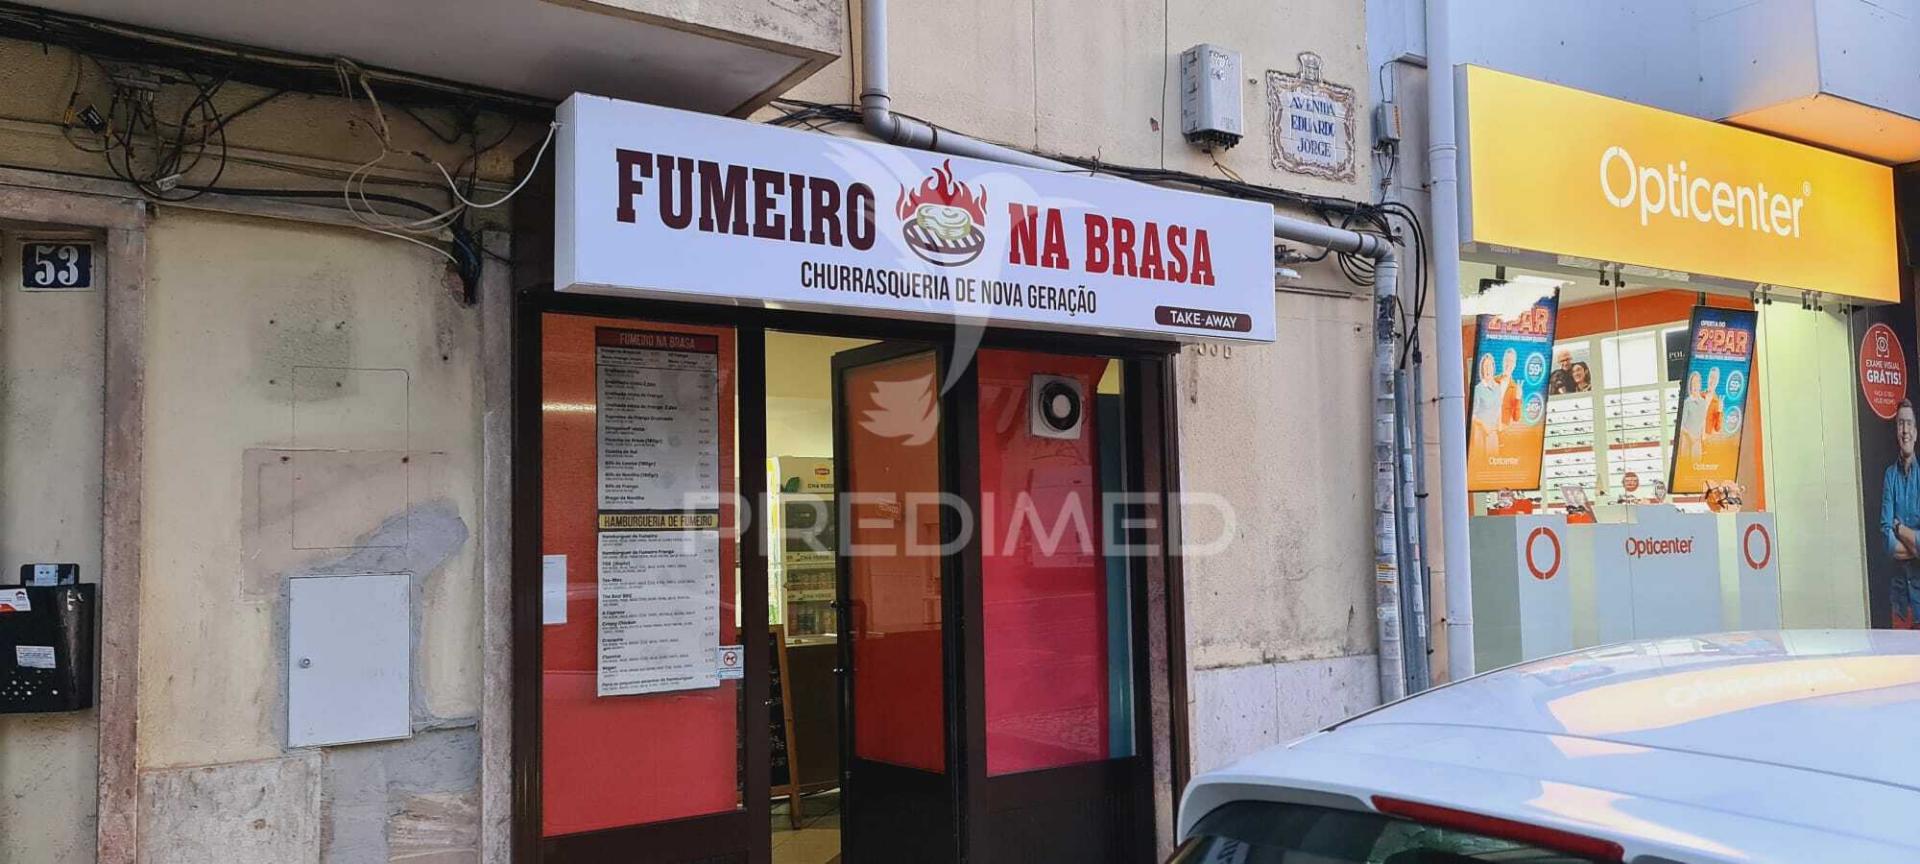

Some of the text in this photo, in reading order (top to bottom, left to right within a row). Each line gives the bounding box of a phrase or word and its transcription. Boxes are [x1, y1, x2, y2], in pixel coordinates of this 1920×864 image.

[1290, 97, 1336, 116] AVENIDA
[1298, 138, 1331, 157] JORGE
[616, 148, 1215, 286] FUMEIRO NA BRASA
[35, 245, 78, 285] 53
[801, 261, 1097, 316] CHURRASQUERIA DE NOVA GERAÇÃO
[1169, 310, 1238, 329] TAKE-AWAY
[669, 336, 696, 349] BRASA
[1866, 368, 1902, 385] GRÁTIS!
[604, 514, 713, 528] HAMBURGUERIA DE FUMEIRO
